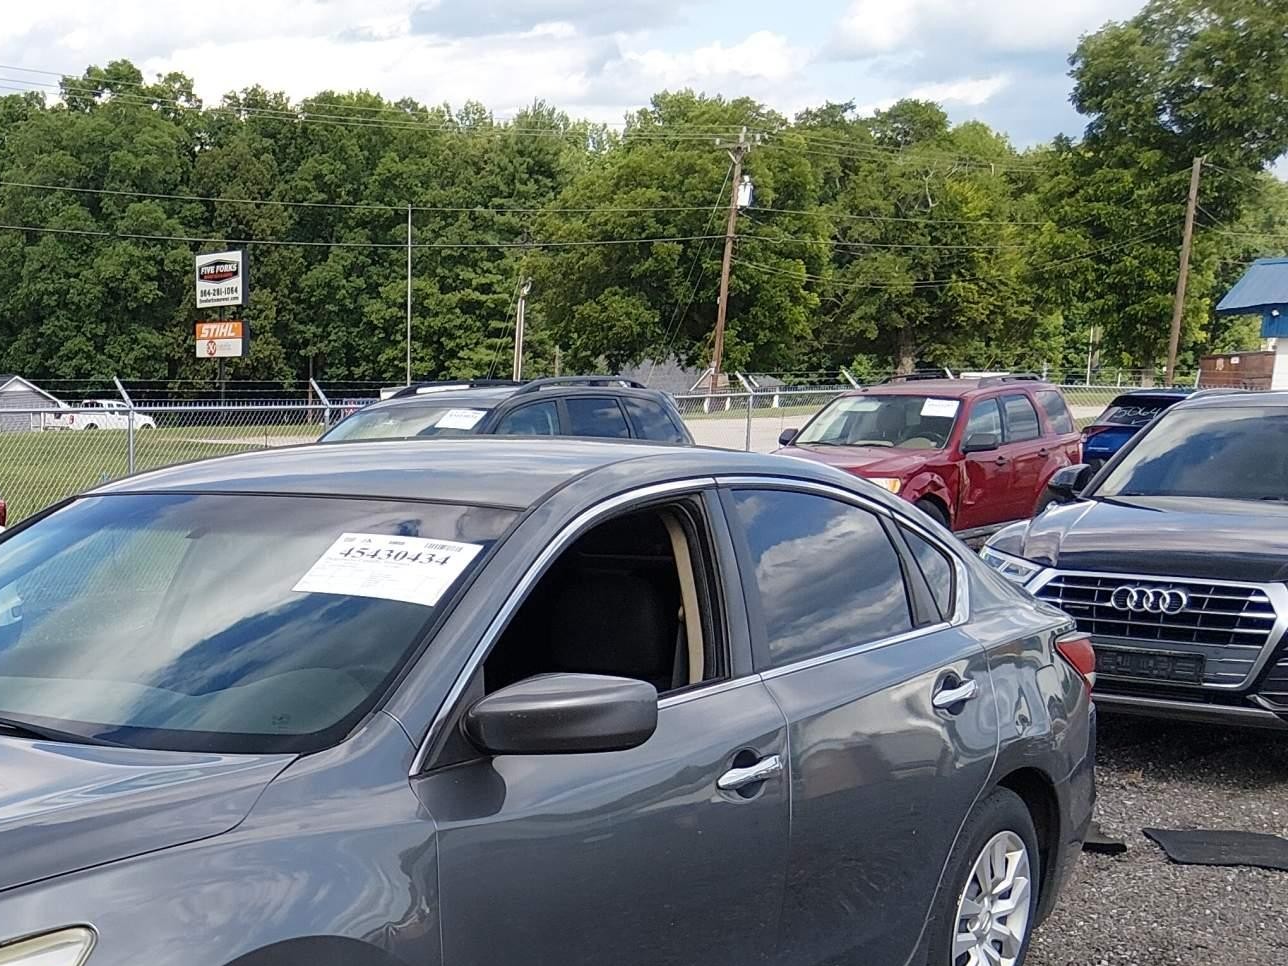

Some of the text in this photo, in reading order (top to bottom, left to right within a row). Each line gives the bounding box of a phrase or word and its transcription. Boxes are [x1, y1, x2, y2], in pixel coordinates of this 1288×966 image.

[200, 263, 238, 275] FIVE FORKS
[200, 323, 236, 338] STIHL
[339, 547, 452, 566] 45430434
